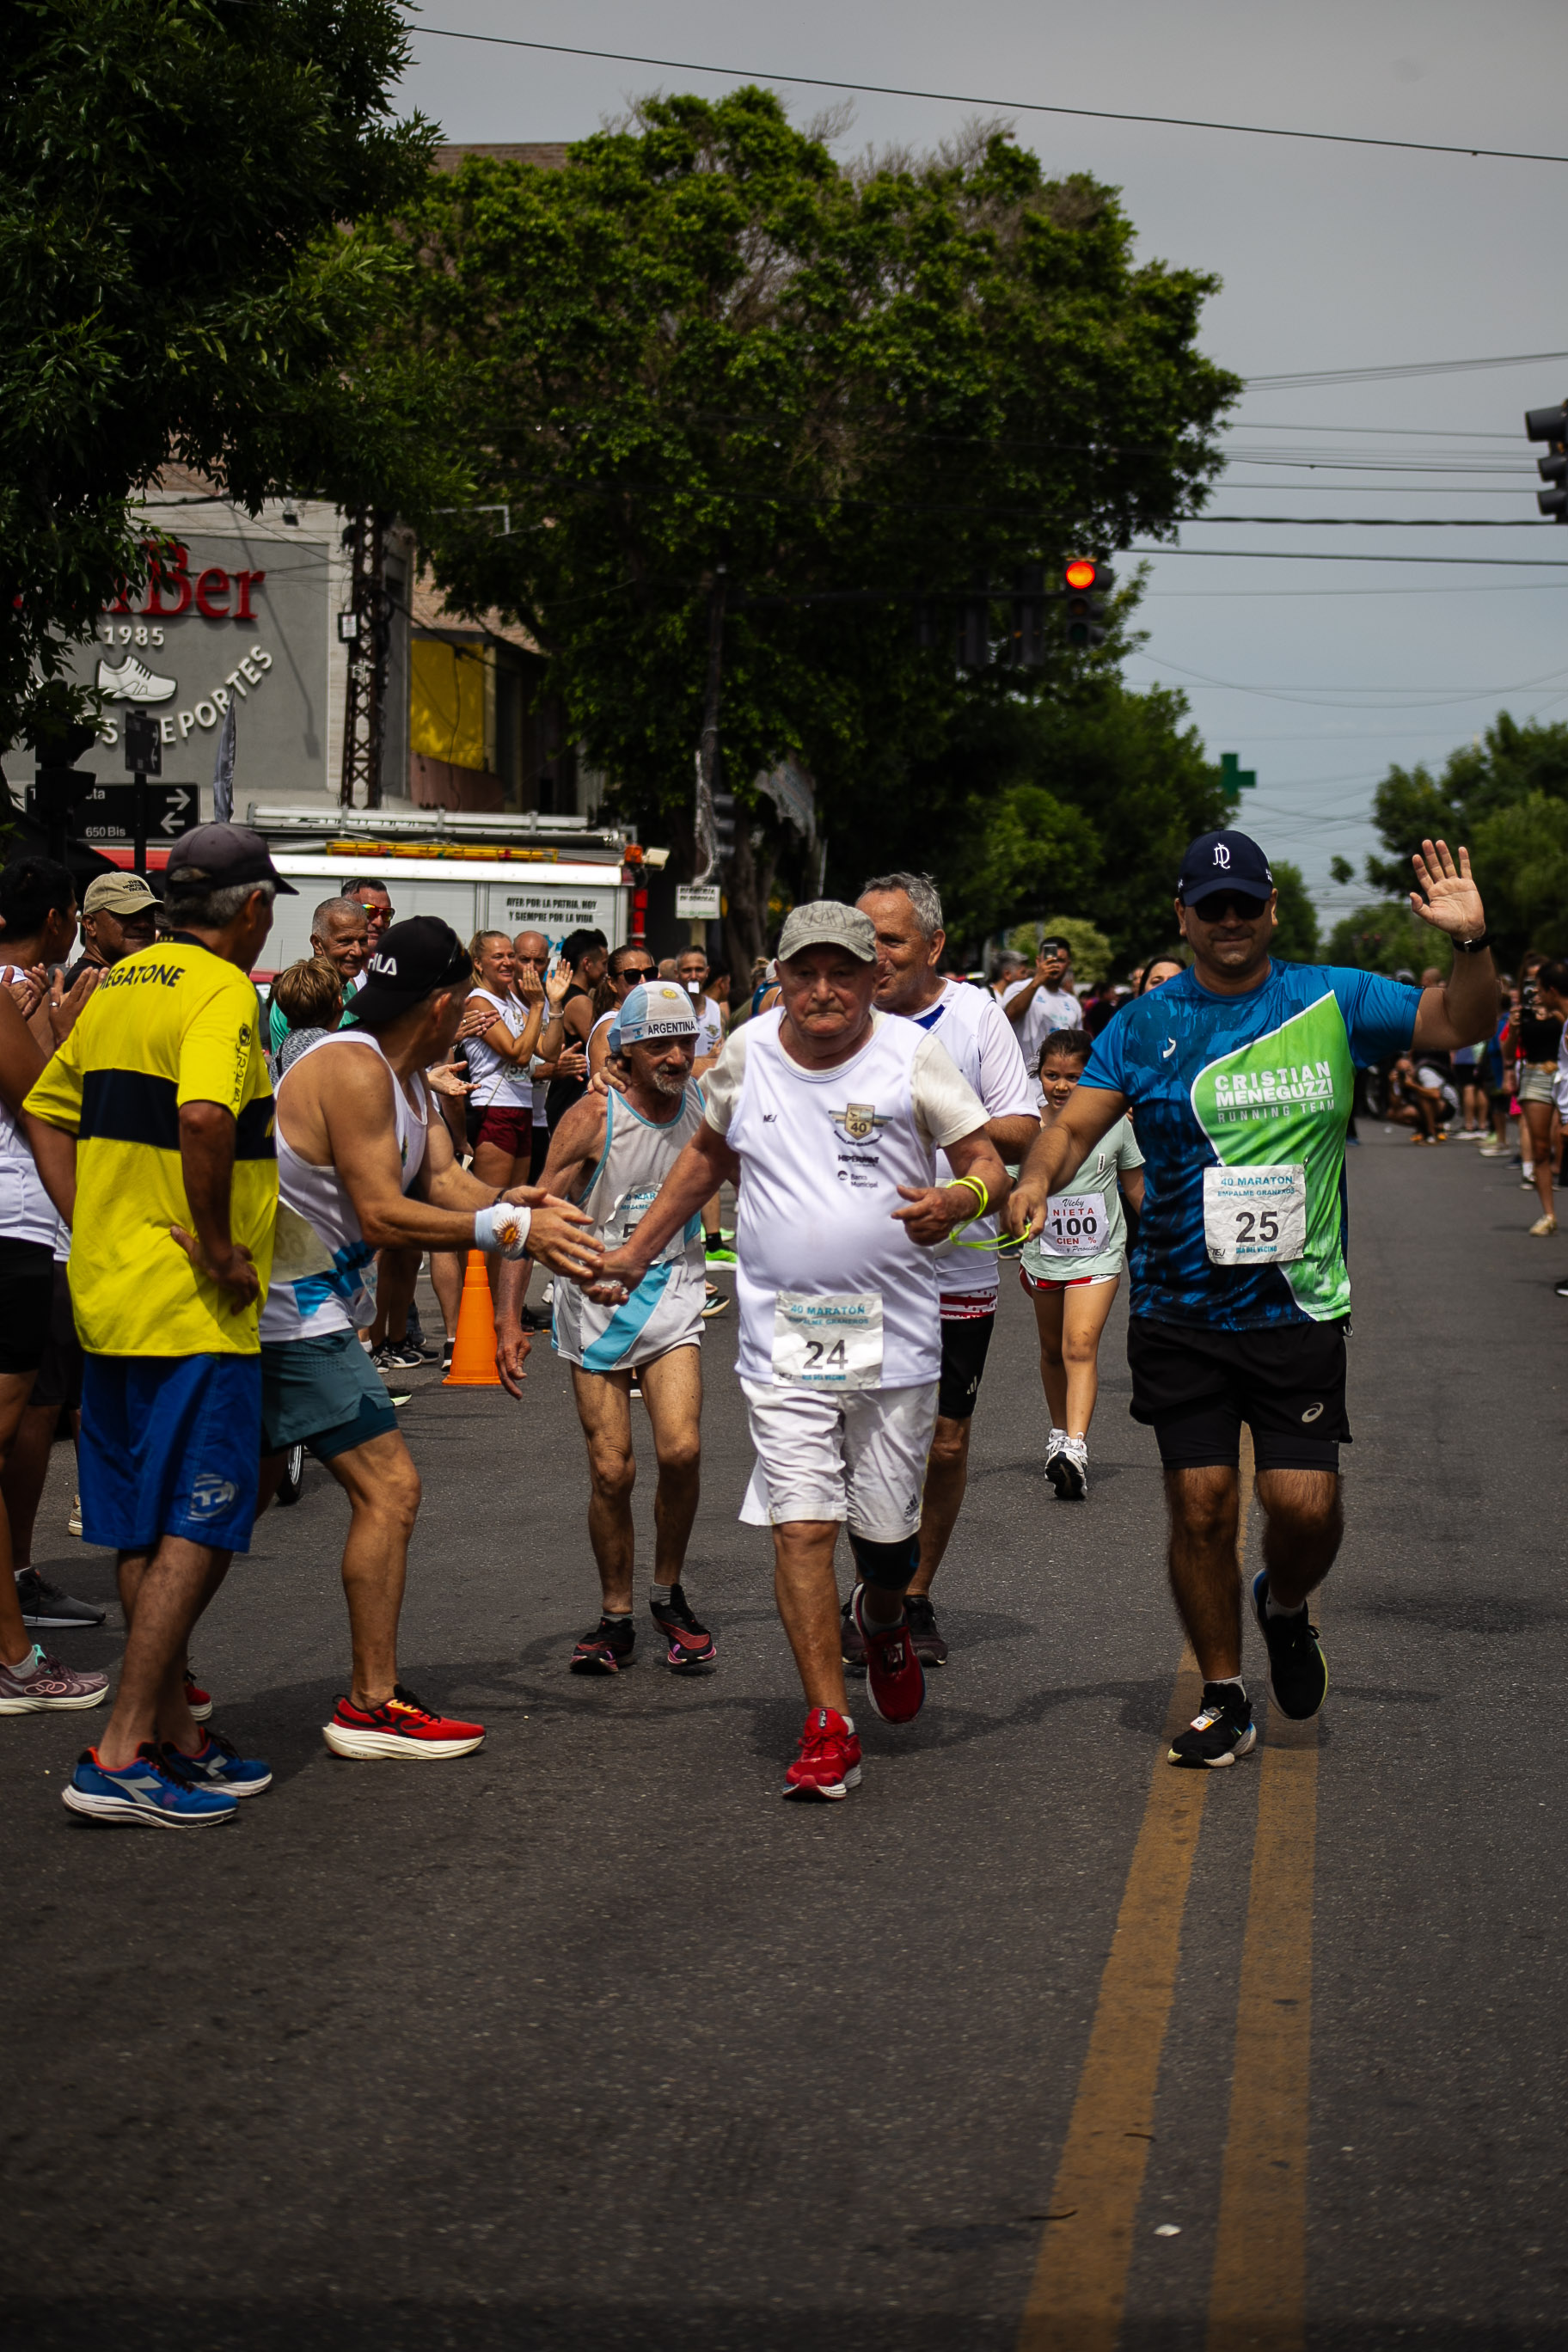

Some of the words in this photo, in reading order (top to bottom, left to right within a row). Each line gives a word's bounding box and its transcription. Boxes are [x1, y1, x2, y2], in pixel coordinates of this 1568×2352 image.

[104, 625, 165, 647] 1985
[160, 645, 273, 744] EPORTES
[85, 826, 106, 838] 650
[107, 826, 126, 838] Bis
[506, 897, 524, 907] AYER
[526, 897, 541, 908] POR
[542, 898, 552, 909] LA
[582, 900, 597, 910] HOY
[509, 911, 514, 922] Y
[515, 911, 548, 922] SIEMPRE
[548, 912, 565, 922] POR
[565, 913, 574, 923] LA
[576, 914, 594, 923] VIDA
[647, 1020, 696, 1035] ARGENTINA
[1215, 1061, 1332, 1091] CRISTIAN
[1216, 1078, 1333, 1108] MENEGUZZI
[1218, 1106, 1290, 1124] RUNNING
[1301, 1099, 1335, 1115] TEAM
[850, 1122, 867, 1133] 40
[1221, 1177, 1234, 1186] 40
[1237, 1175, 1293, 1186] MARATON
[1256, 1187, 1295, 1197] GRANEROS
[1063, 1197, 1085, 1207] Vicky
[1053, 1207, 1094, 1216] NIETA
[1051, 1216, 1097, 1236] 100
[1235, 1210, 1279, 1243] 25
[791, 1304, 803, 1314] 40
[803, 1338, 849, 1369] 24
